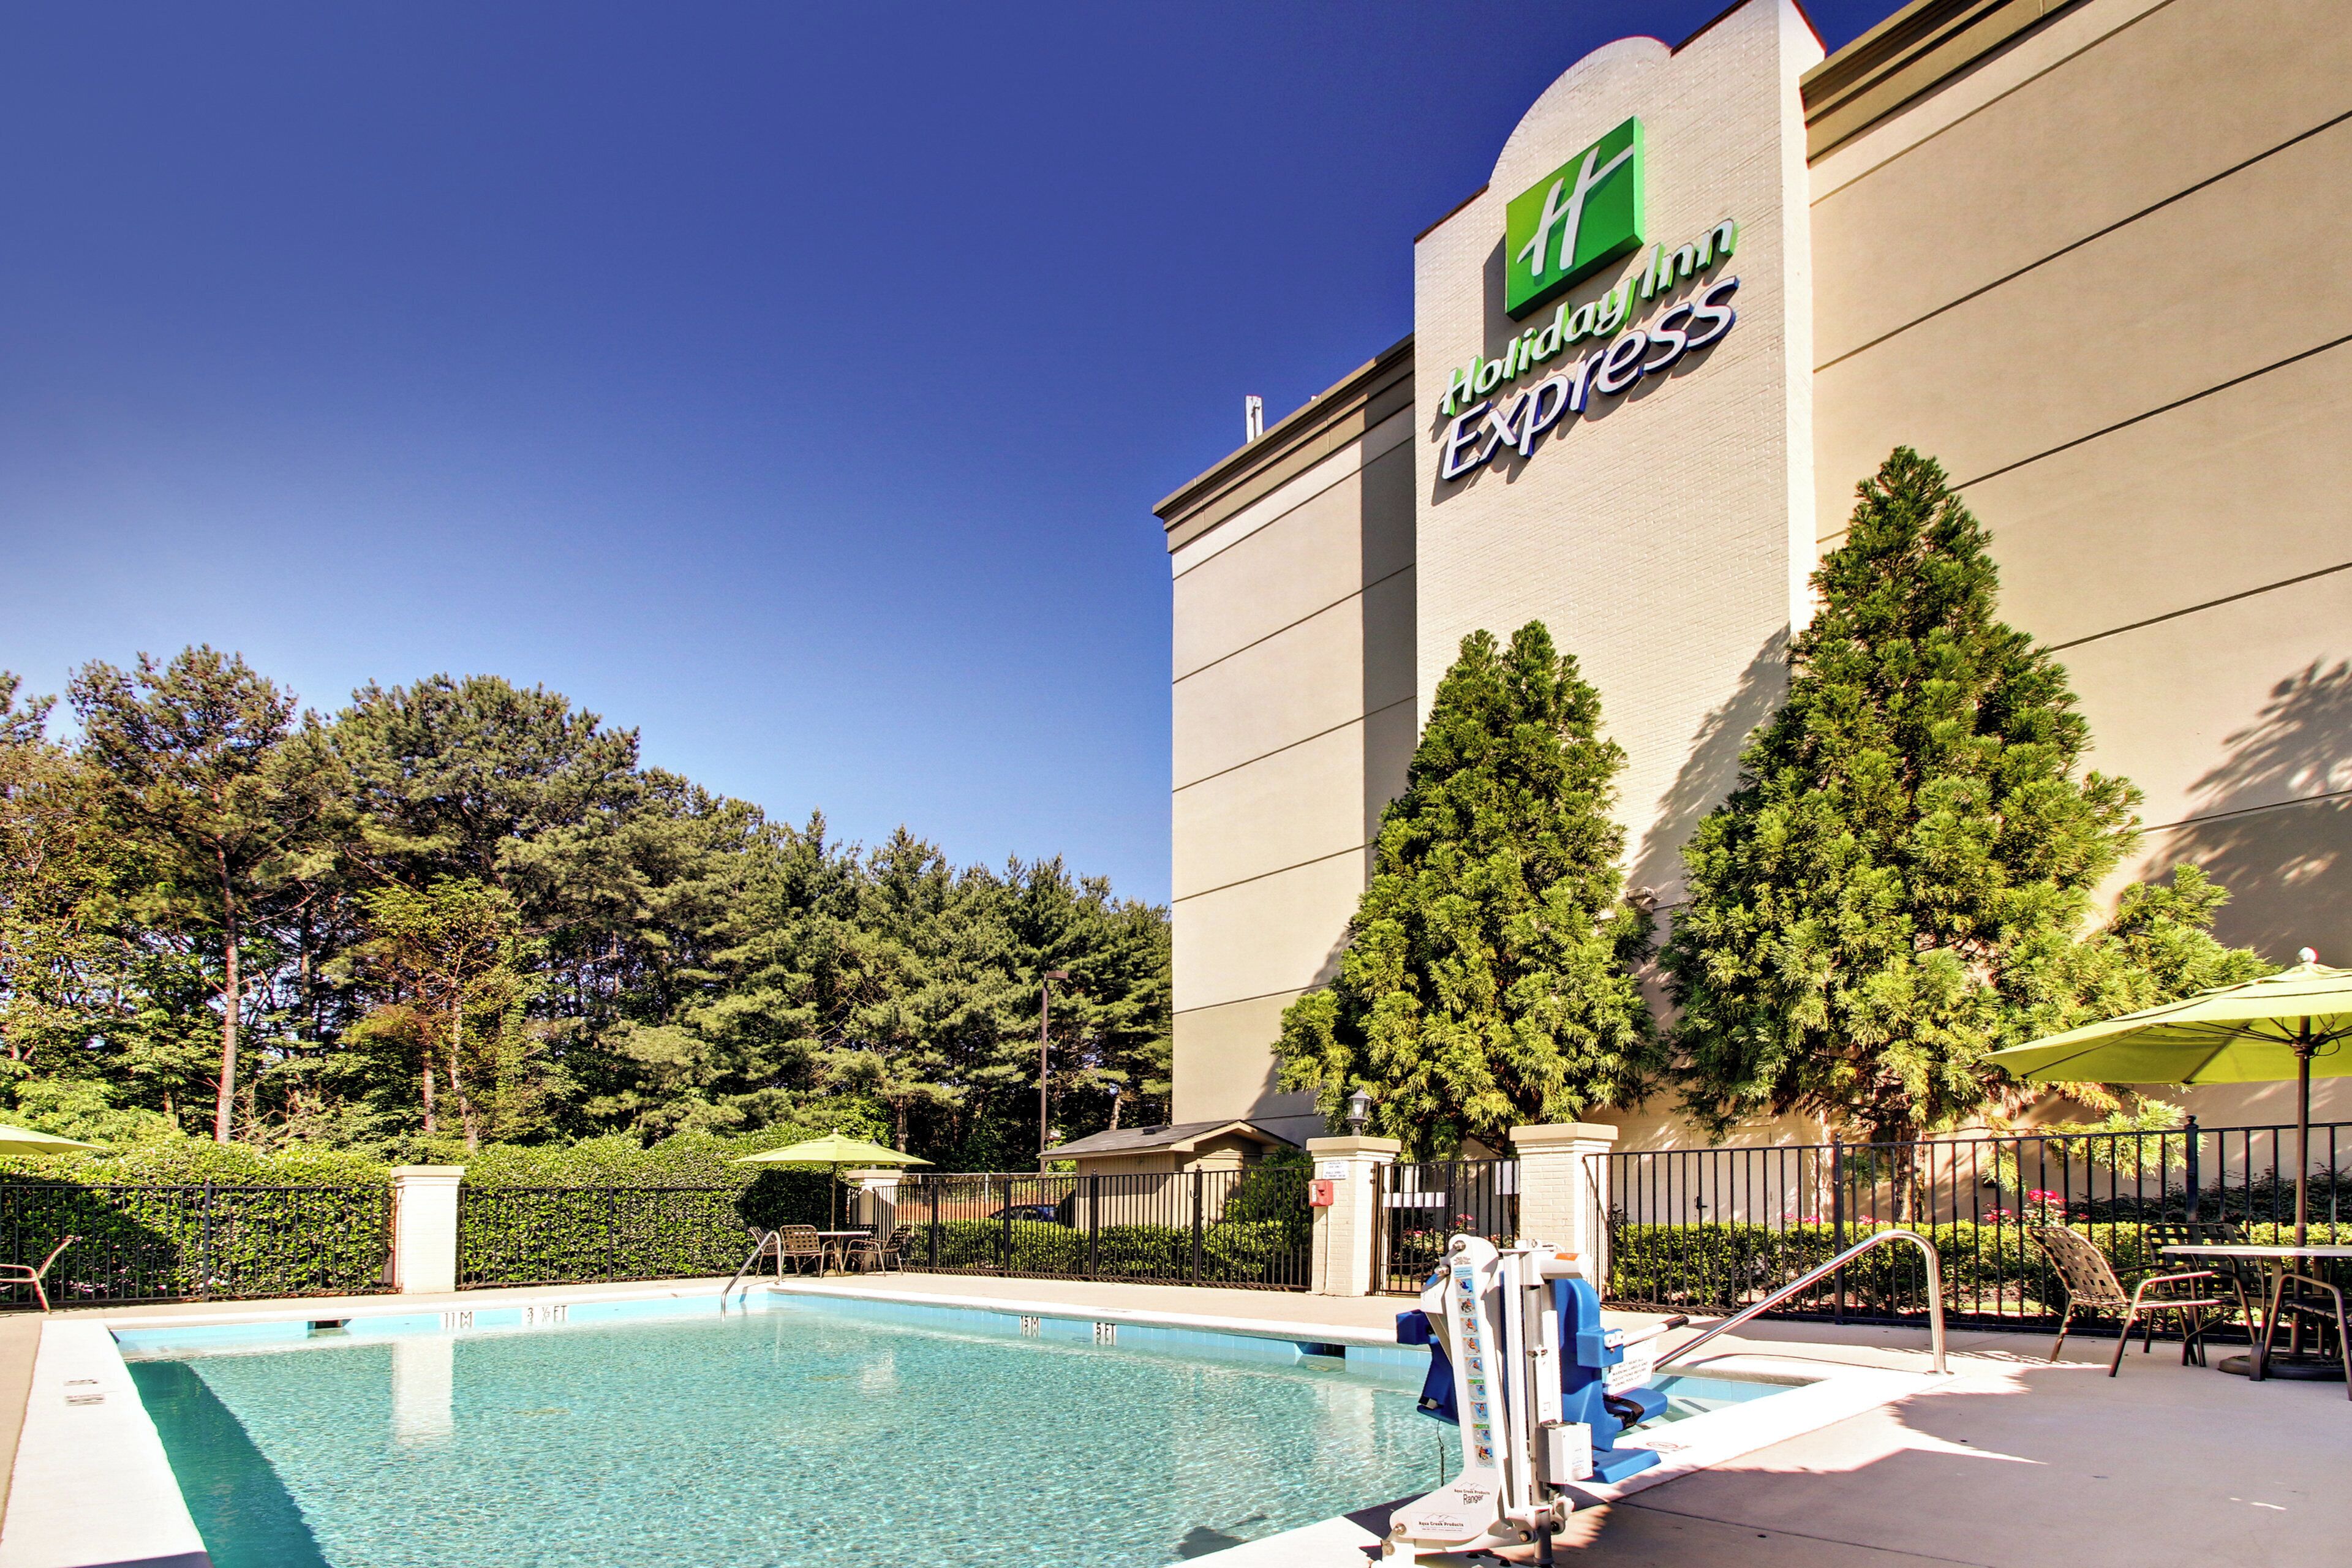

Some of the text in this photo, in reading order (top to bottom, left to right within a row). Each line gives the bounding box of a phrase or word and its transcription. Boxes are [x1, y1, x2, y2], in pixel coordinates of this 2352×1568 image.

[1439, 218, 1737, 415] Holiday Inn
[1442, 276, 1740, 480] Express
[554, 1305, 567, 1319] FT
[1031, 1317, 1039, 1330] M
[1096, 1322, 1115, 1336] 5 FT
[1463, 1494, 1483, 1505] Ranger
